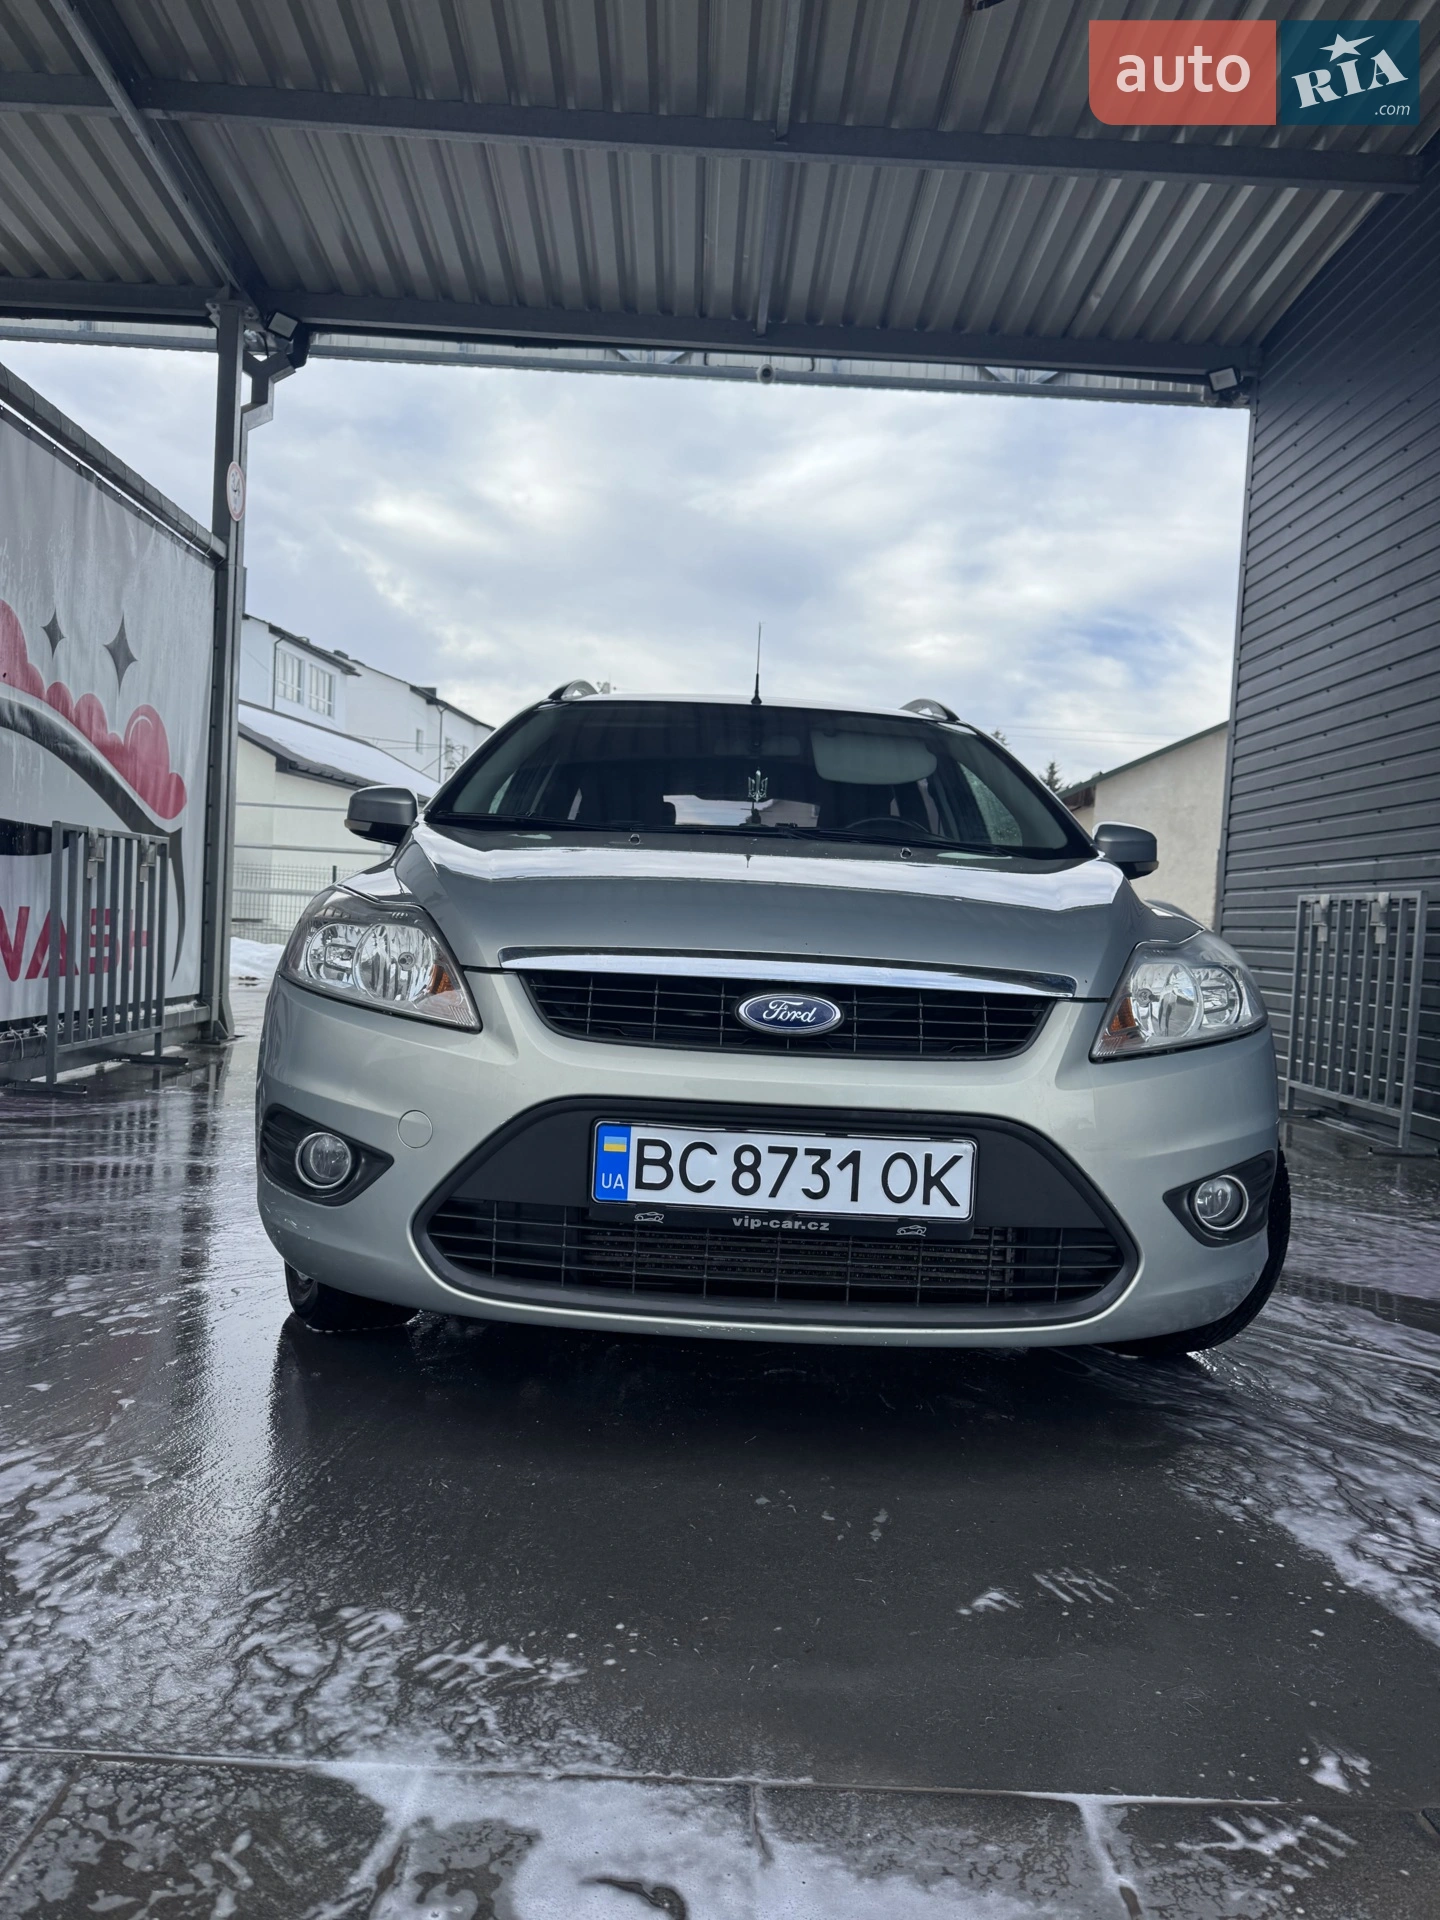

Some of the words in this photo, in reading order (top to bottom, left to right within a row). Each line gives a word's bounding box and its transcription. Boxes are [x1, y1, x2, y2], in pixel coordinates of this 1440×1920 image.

[762, 999, 817, 1023] Ford
[601, 1172, 625, 1190] UA
[635, 1137, 718, 1194] BC
[731, 1143, 862, 1203] 8731
[880, 1151, 964, 1208] OK
[732, 1215, 830, 1231] vip-car.cz
